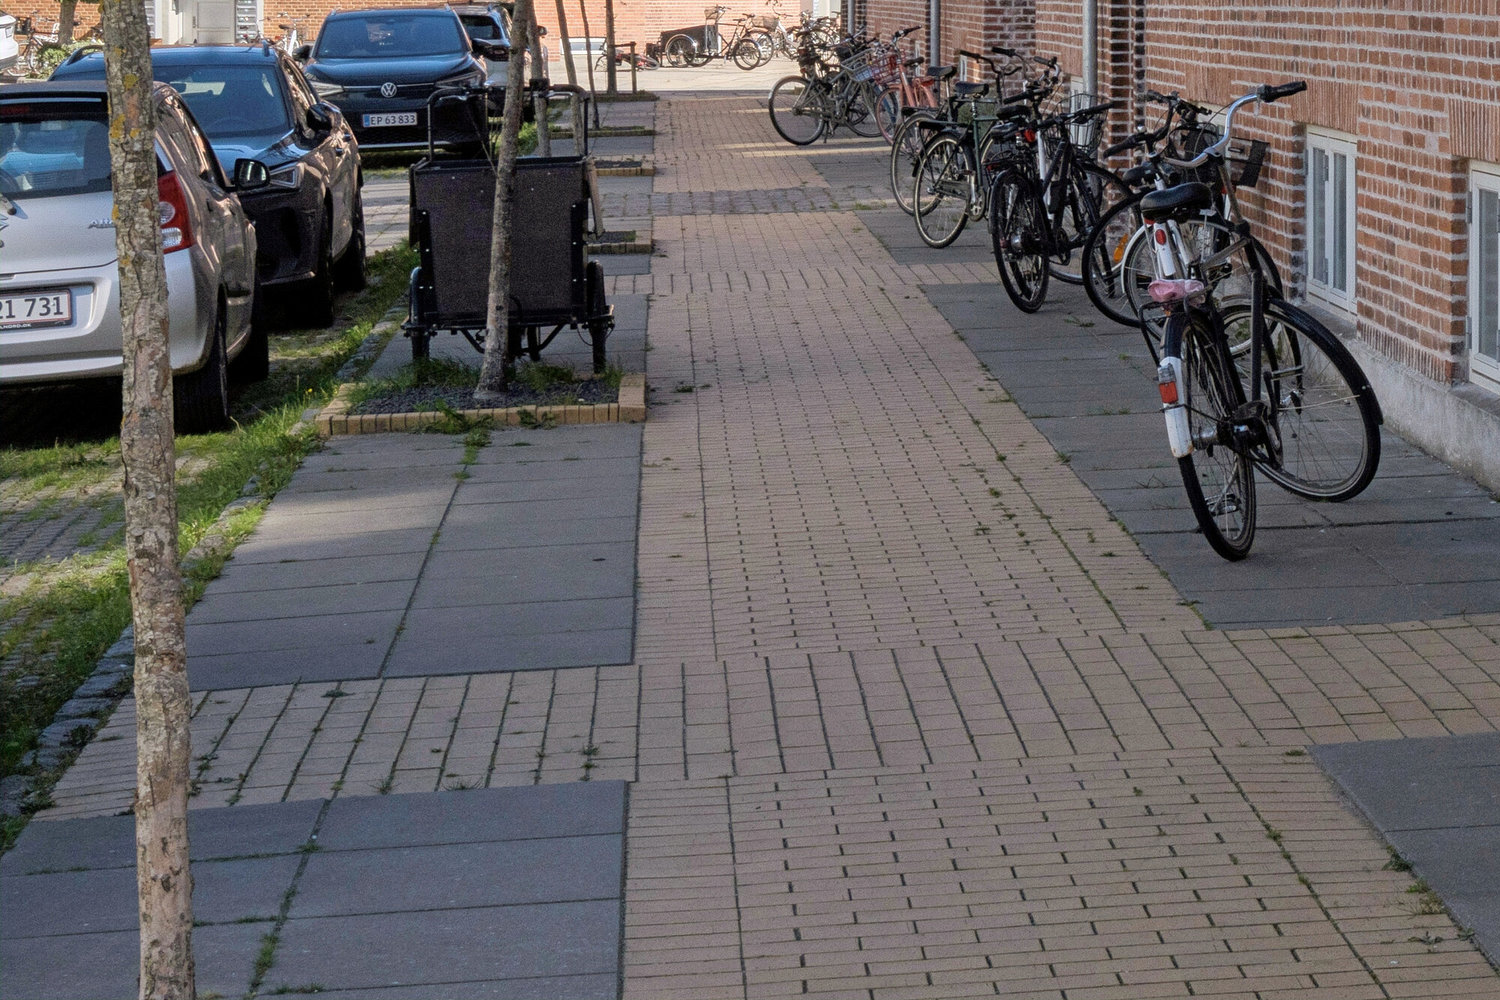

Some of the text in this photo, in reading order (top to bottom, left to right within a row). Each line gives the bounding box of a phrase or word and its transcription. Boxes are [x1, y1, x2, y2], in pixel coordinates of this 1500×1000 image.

[370, 115, 415, 125] EP 63 833
[24, 296, 63, 317] 731
